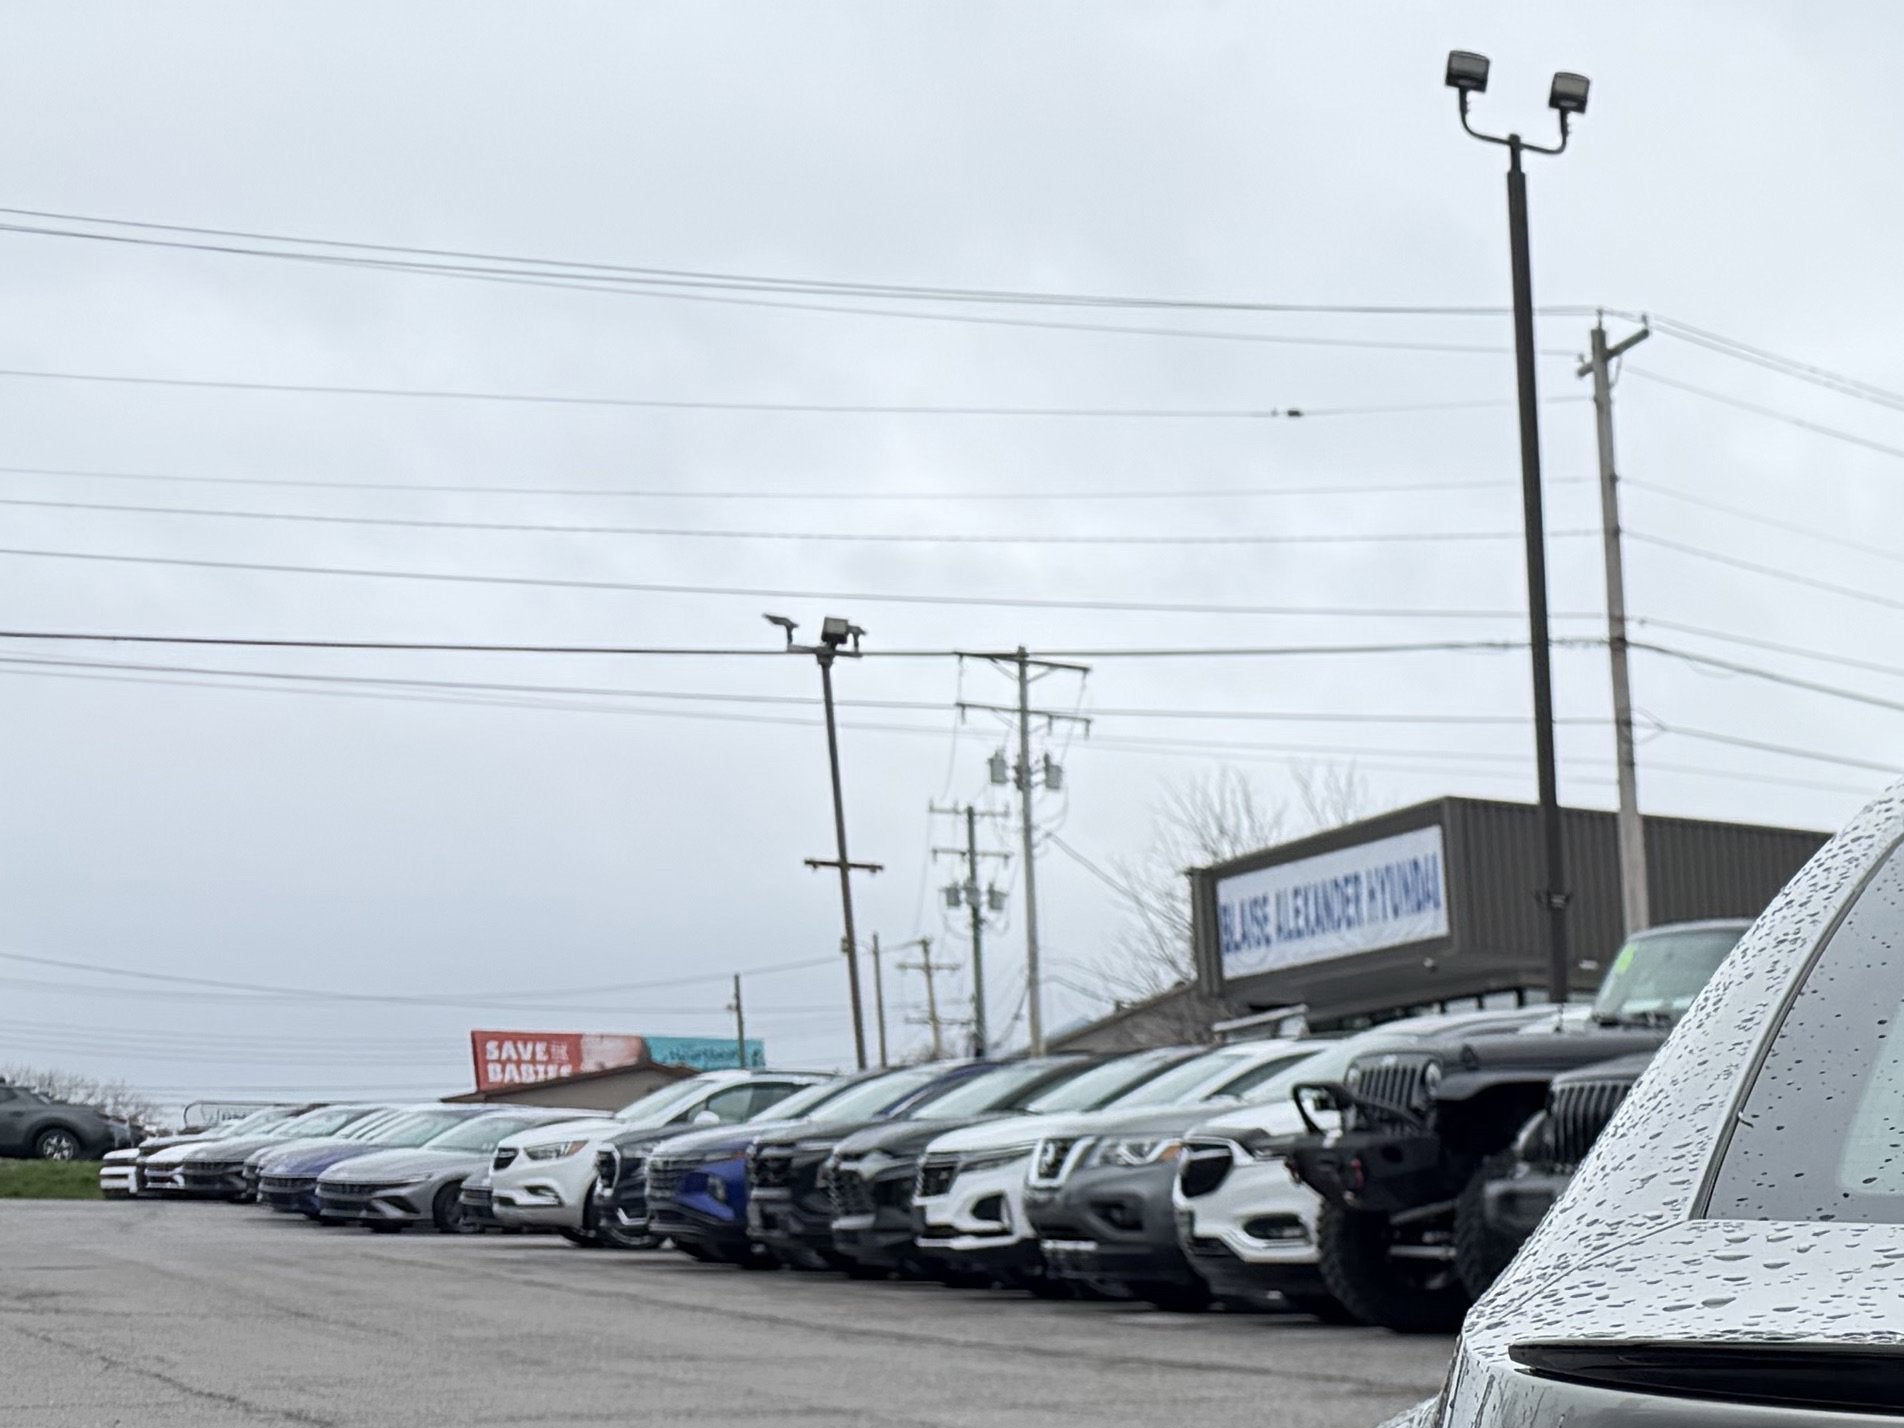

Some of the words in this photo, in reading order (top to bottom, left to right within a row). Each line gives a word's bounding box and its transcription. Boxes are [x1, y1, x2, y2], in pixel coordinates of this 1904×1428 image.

[1221, 892, 1271, 953] BLAISE
[1274, 873, 1362, 941] ALEXANDER
[1364, 852, 1441, 923] HYUNDAI
[486, 1040, 548, 1060] SAVE
